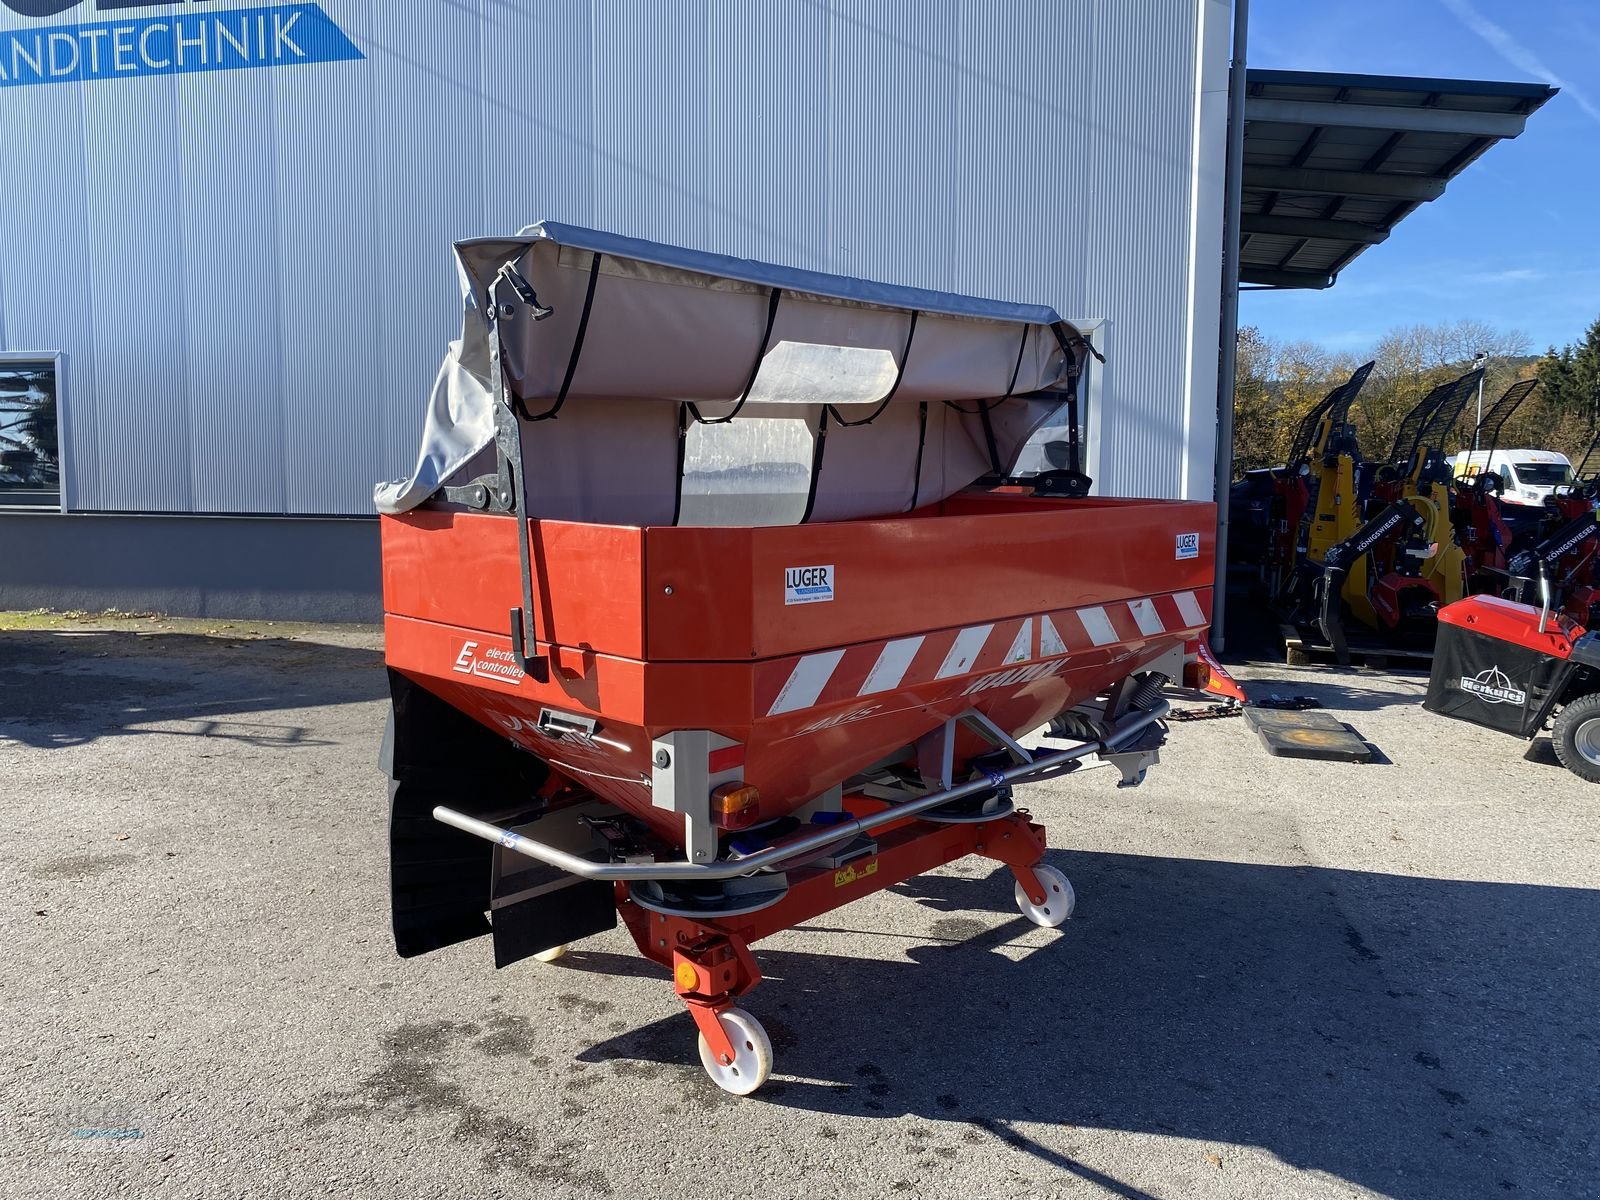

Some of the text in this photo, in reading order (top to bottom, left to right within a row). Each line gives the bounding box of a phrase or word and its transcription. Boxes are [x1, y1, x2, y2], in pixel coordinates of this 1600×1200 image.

[1177, 535, 1196, 548] LUGER
[1546, 524, 1597, 561] KÖNIGSWIESER
[786, 568, 828, 588] LUGER
[456, 641, 478, 666] E
[1463, 680, 1522, 702] Herkules
